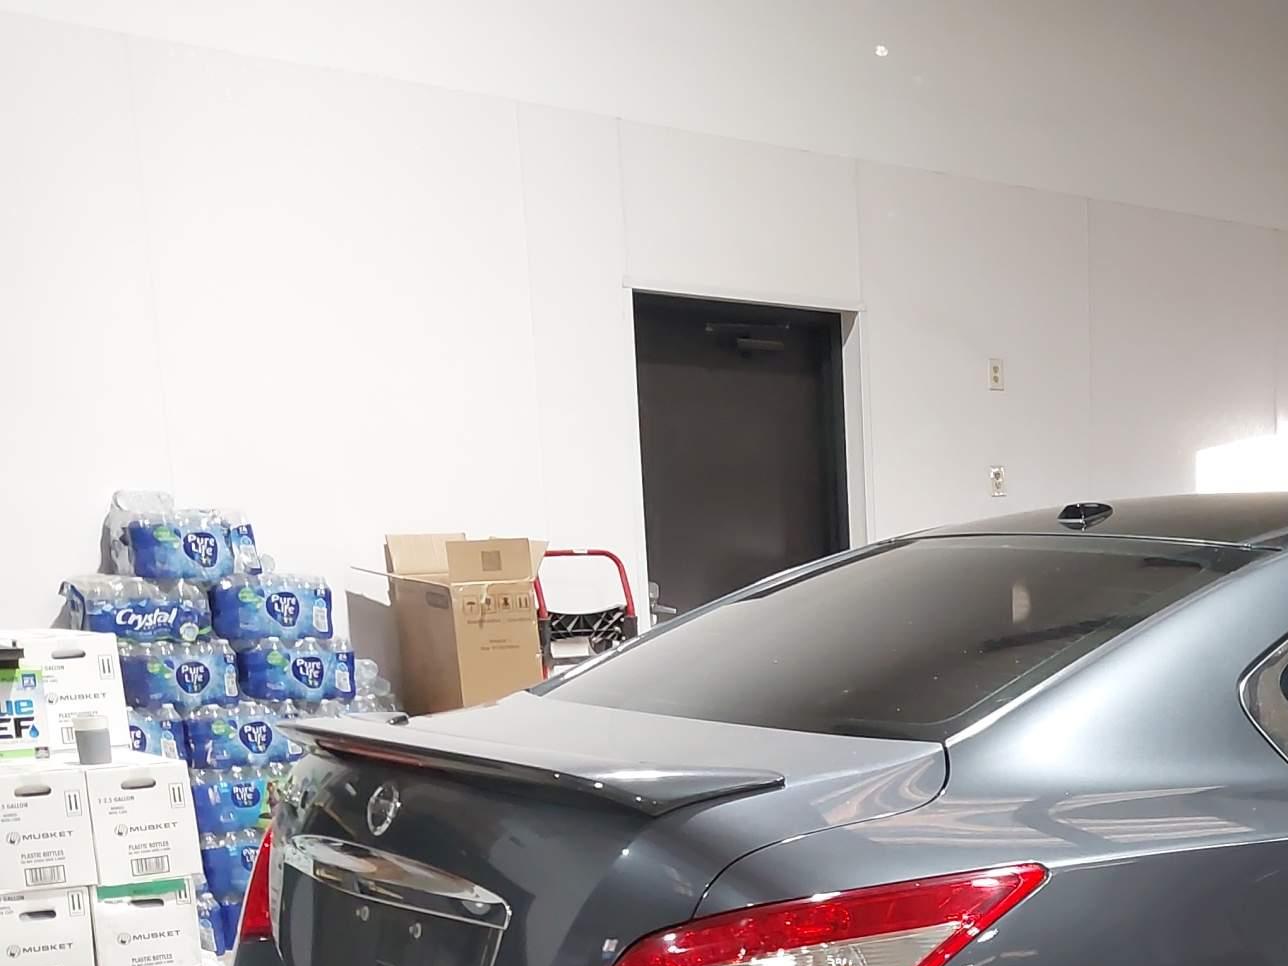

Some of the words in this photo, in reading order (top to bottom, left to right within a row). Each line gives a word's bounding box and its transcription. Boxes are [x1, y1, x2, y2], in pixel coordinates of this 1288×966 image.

[187, 534, 215, 548] Pure
[191, 543, 213, 560] Life
[271, 595, 297, 607] Pure
[274, 602, 295, 617] Life
[115, 607, 178, 630] Crystal
[181, 665, 205, 676] Pure
[296, 659, 321, 671] Pure
[184, 673, 204, 685] Life
[299, 667, 320, 681] Life
[243, 725, 267, 736] Pure
[248, 733, 267, 747] Life
[233, 784, 255, 795] Pure
[236, 792, 253, 806] Life
[129, 821, 178, 833] MUSKET
[22, 830, 74, 841] MUSKET
[132, 929, 181, 941] MUSKET
[22, 942, 73, 953] MUSKET
